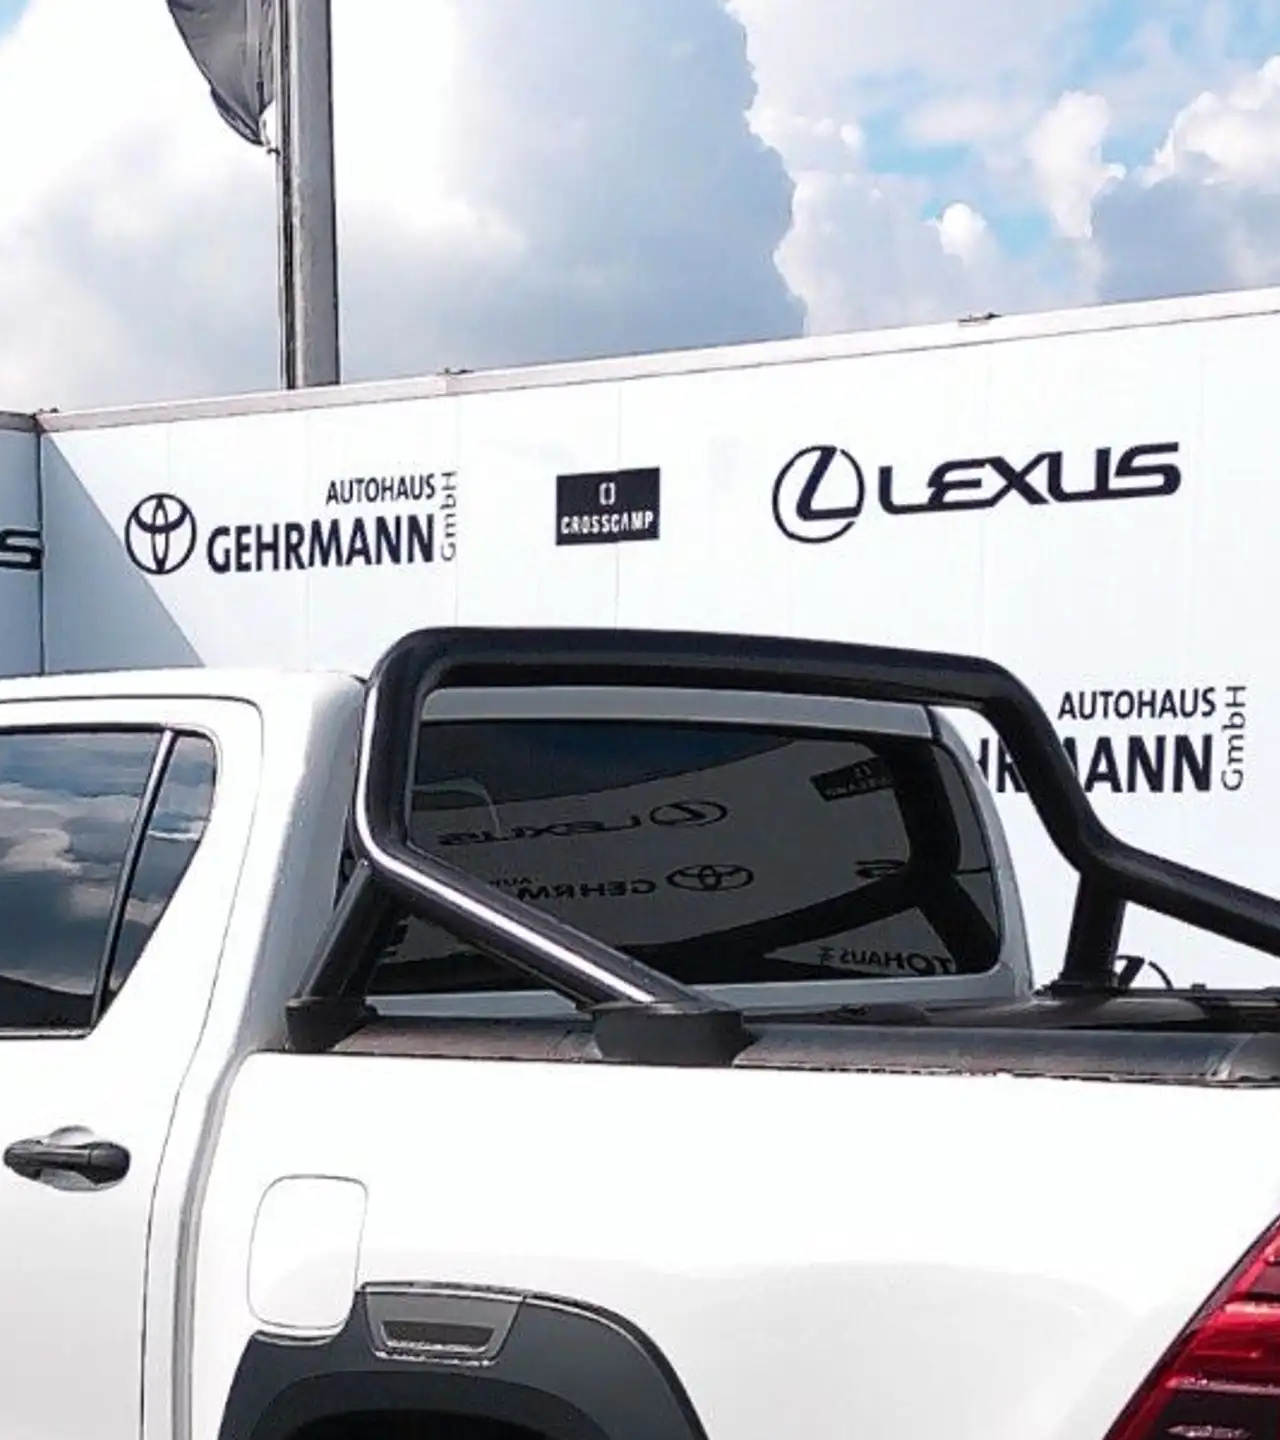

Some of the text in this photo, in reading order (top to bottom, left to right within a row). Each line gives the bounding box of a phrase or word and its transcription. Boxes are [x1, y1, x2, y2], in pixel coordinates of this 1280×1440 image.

[325, 472, 436, 506] AUTOHAUS
[878, 441, 1182, 516] LEXUS
[206, 513, 434, 575] GEHRMANN
[439, 471, 457, 562] GmbH
[560, 510, 654, 535] CROSSCAMP
[1057, 686, 1217, 721] AUTOHAUS
[1220, 685, 1247, 792] GmbH
